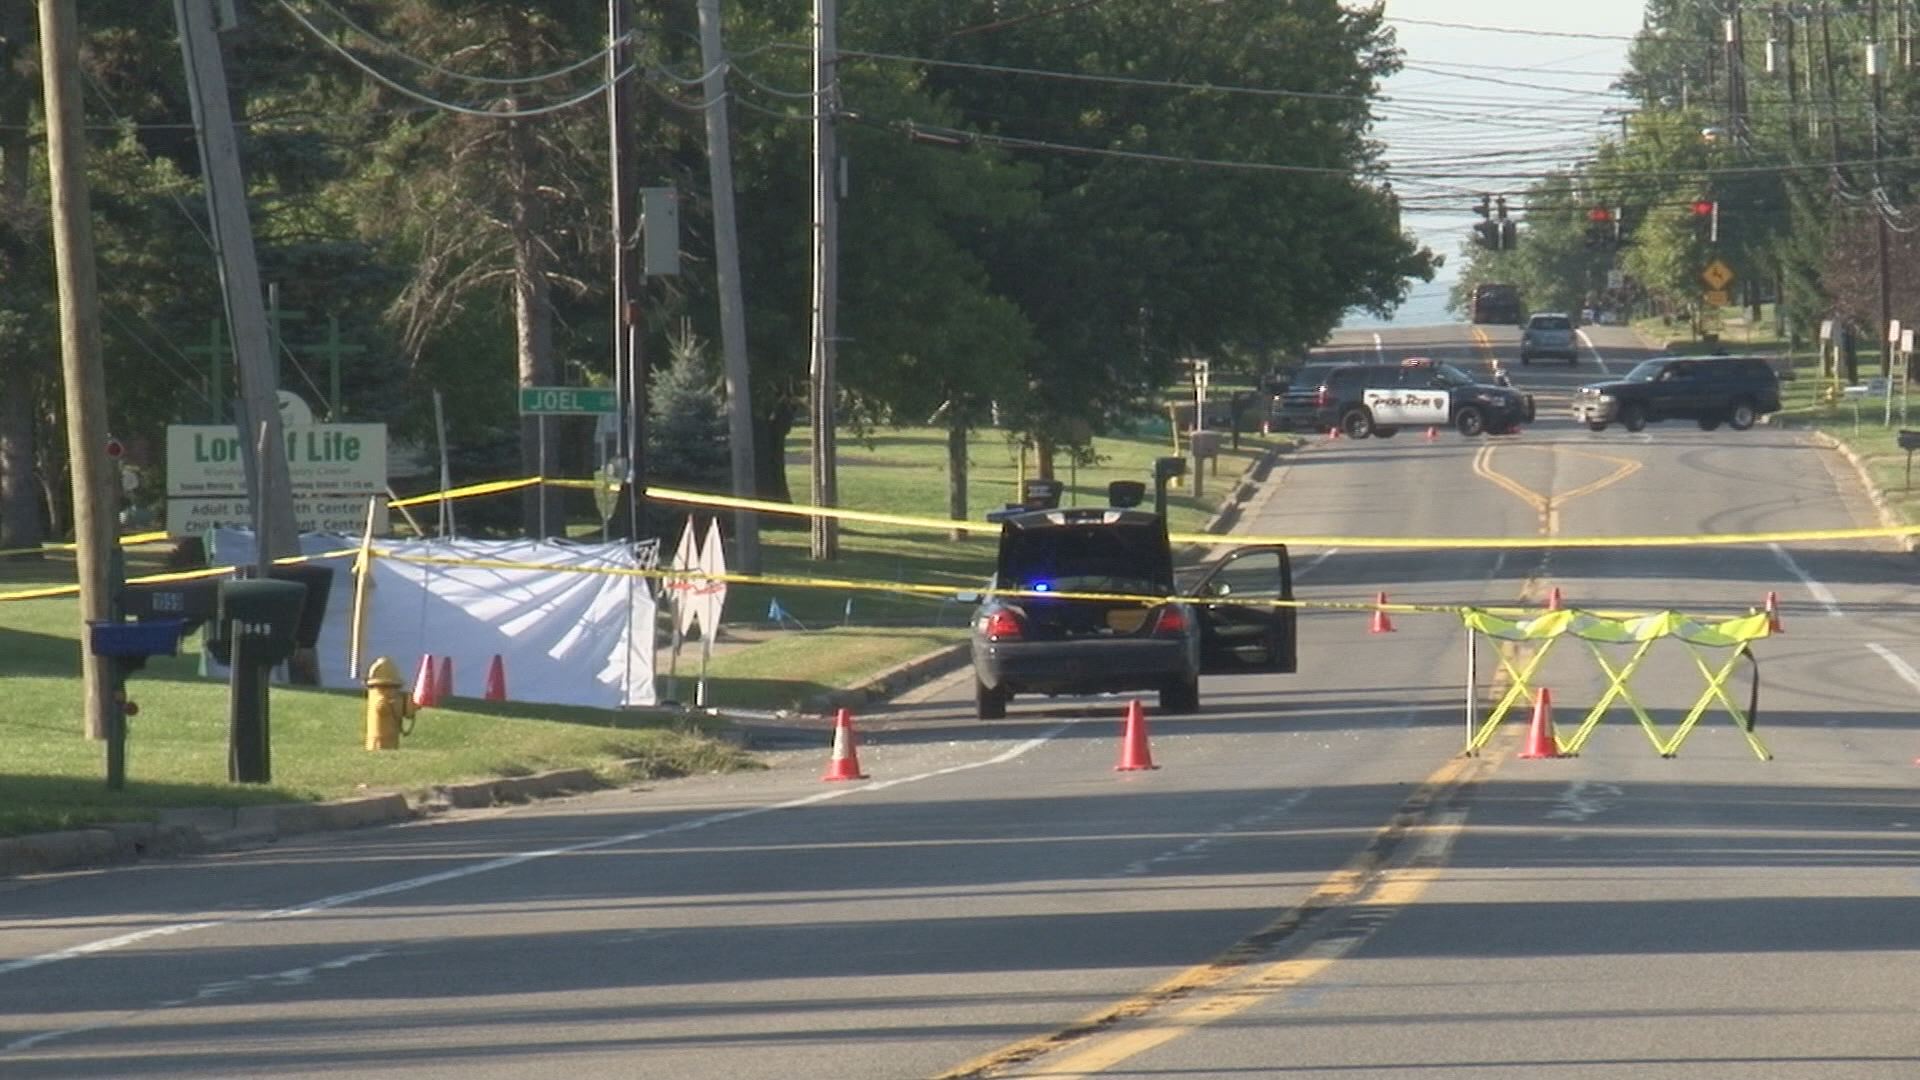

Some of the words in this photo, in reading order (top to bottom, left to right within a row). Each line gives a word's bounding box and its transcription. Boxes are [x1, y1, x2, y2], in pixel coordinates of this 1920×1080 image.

[530, 391, 585, 410] JOEL
[1368, 393, 1430, 408] POLICE
[194, 432, 241, 462] Lor
[307, 431, 361, 461] Life
[191, 503, 228, 516] Adult
[316, 503, 362, 514] Center
